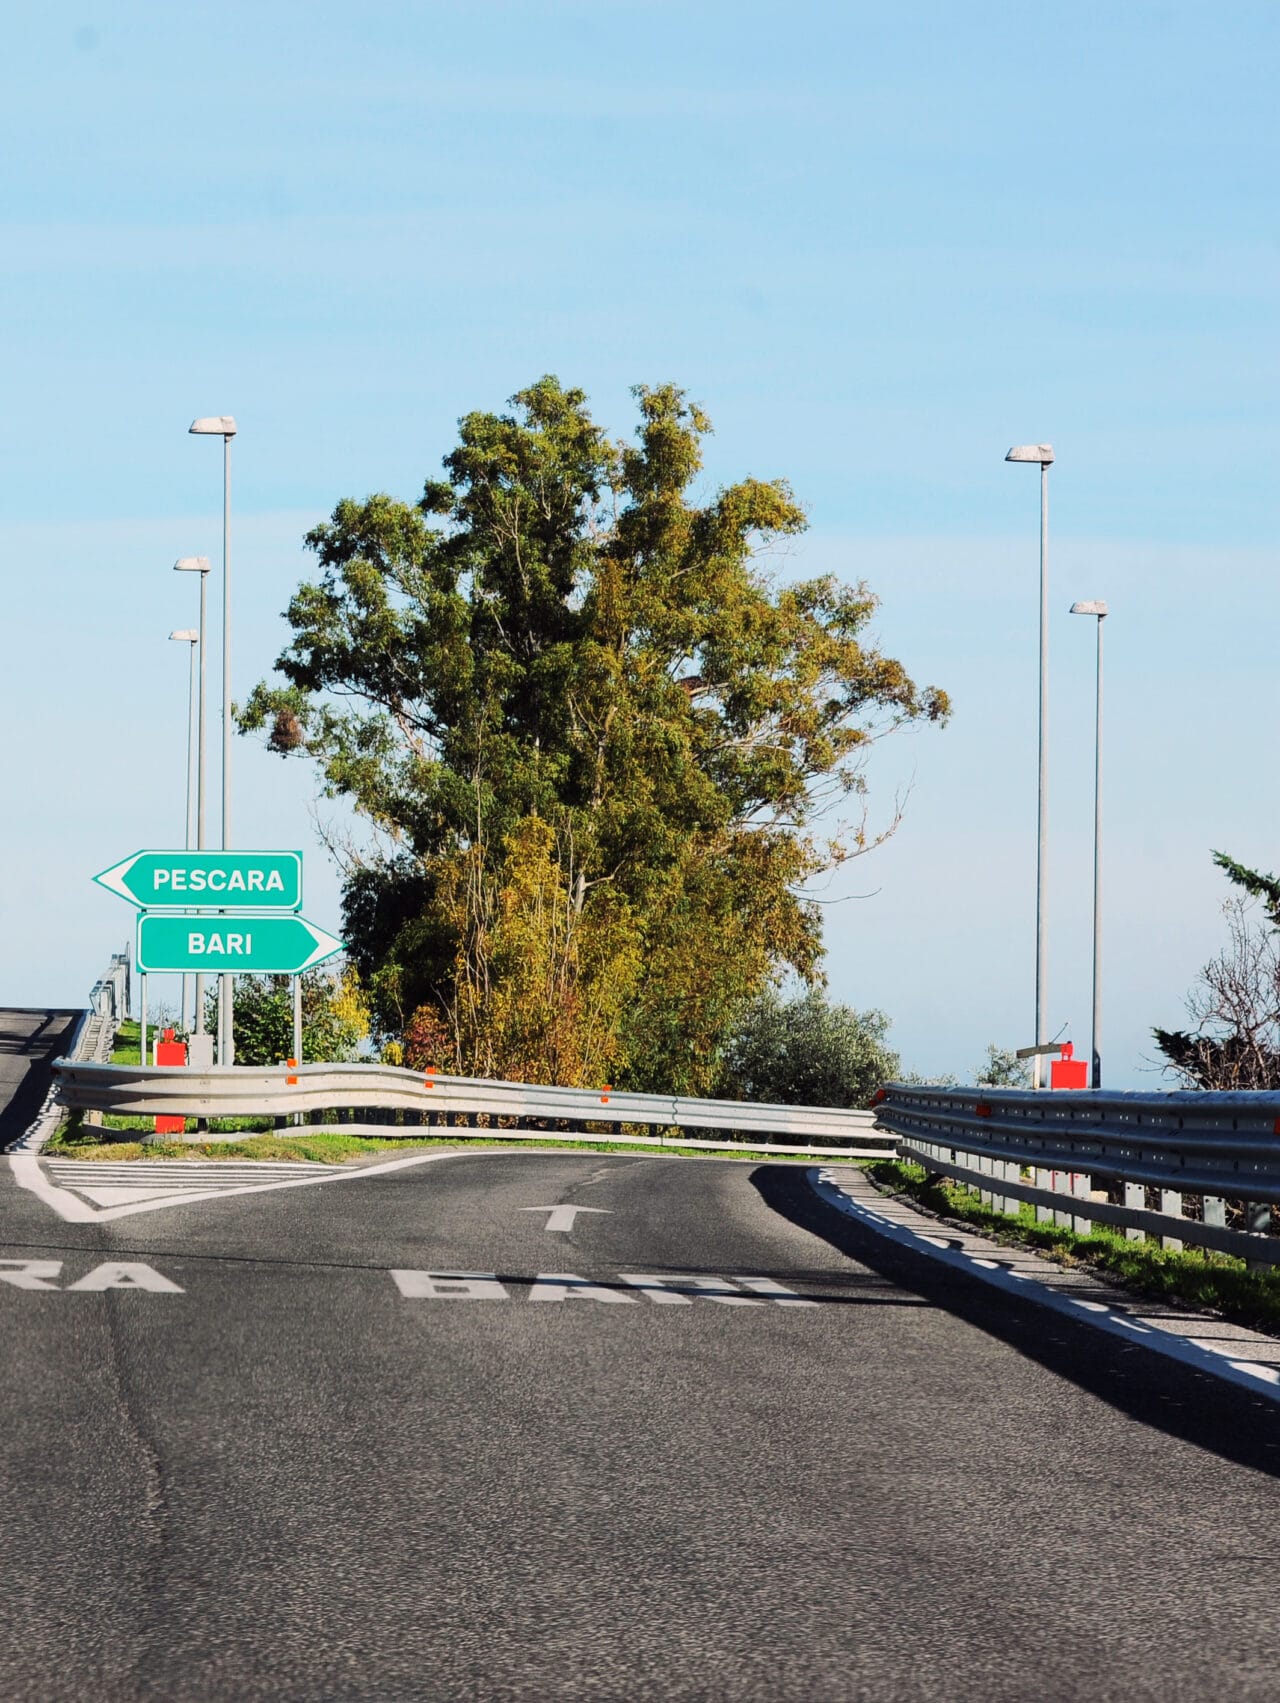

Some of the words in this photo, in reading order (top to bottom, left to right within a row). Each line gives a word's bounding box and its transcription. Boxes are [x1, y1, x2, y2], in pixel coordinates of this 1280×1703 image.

[153, 869, 284, 891] PESCARA
[188, 933, 252, 955] BARI
[389, 1269, 820, 1307] BARI
